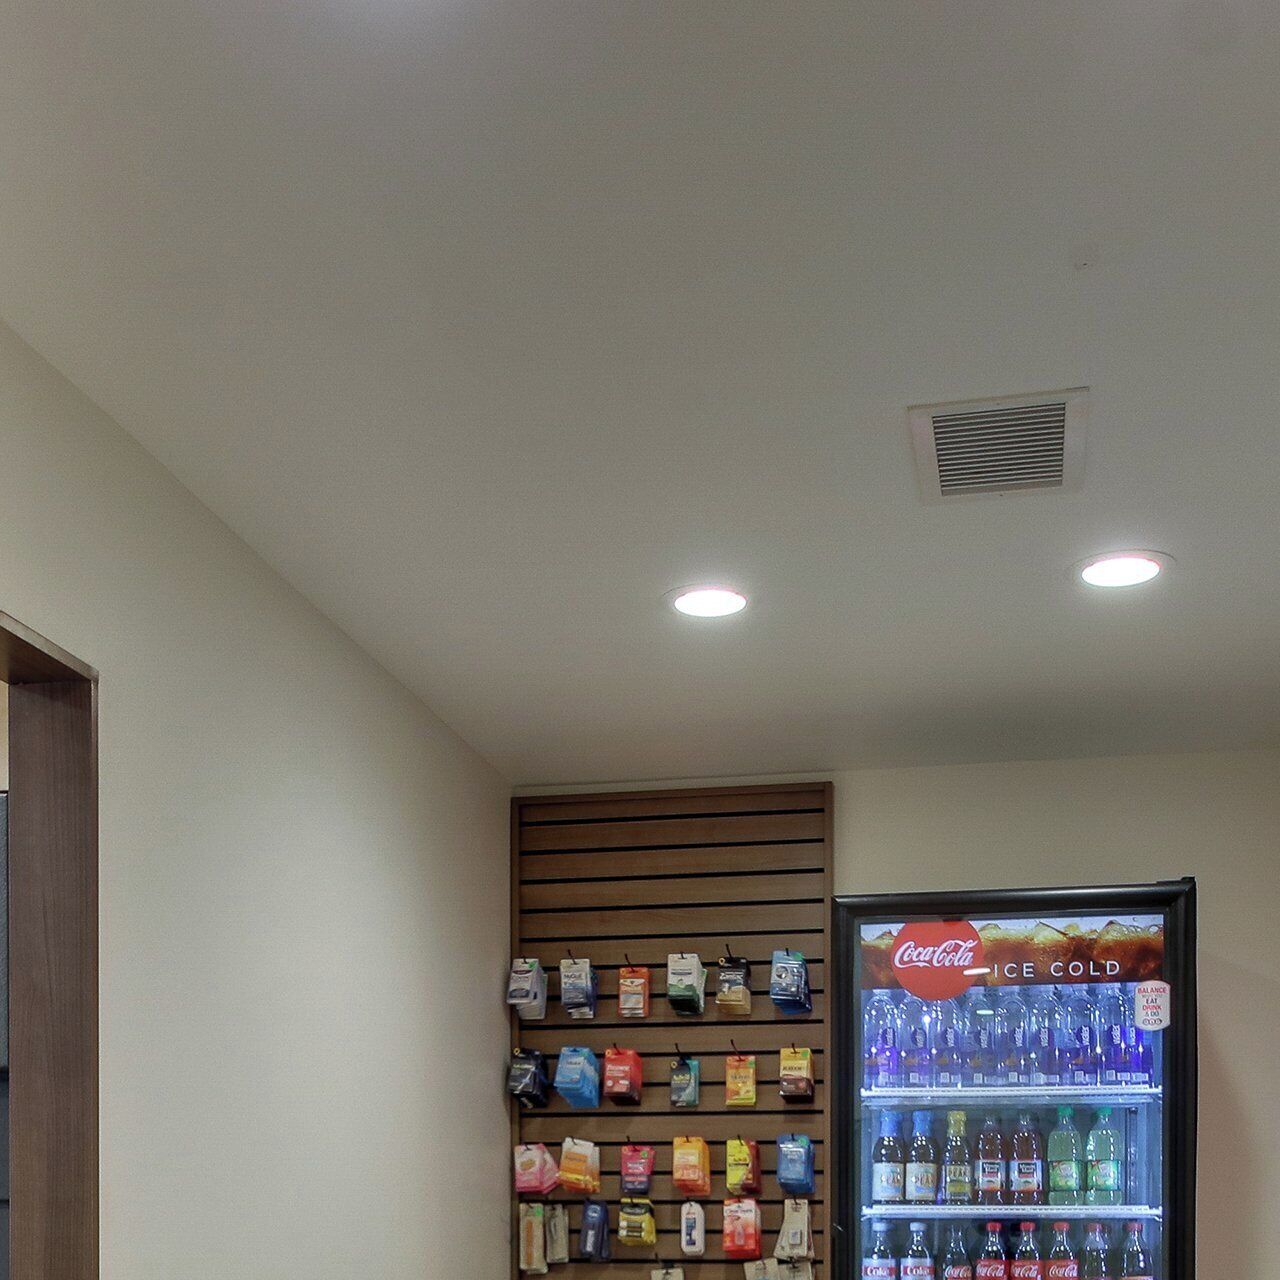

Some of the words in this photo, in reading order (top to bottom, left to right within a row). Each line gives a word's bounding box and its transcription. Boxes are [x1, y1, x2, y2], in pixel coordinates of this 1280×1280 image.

[894, 939, 979, 969] Coca-Cola
[994, 961, 1036, 979] ICE
[1050, 959, 1122, 978] COLD
[1137, 986, 1168, 995] BALANCE
[1146, 997, 1158, 1005] EAT
[1142, 1004, 1162, 1012] DRINK
[867, 1266, 890, 1277] Coke
[906, 1265, 930, 1276] Coke
